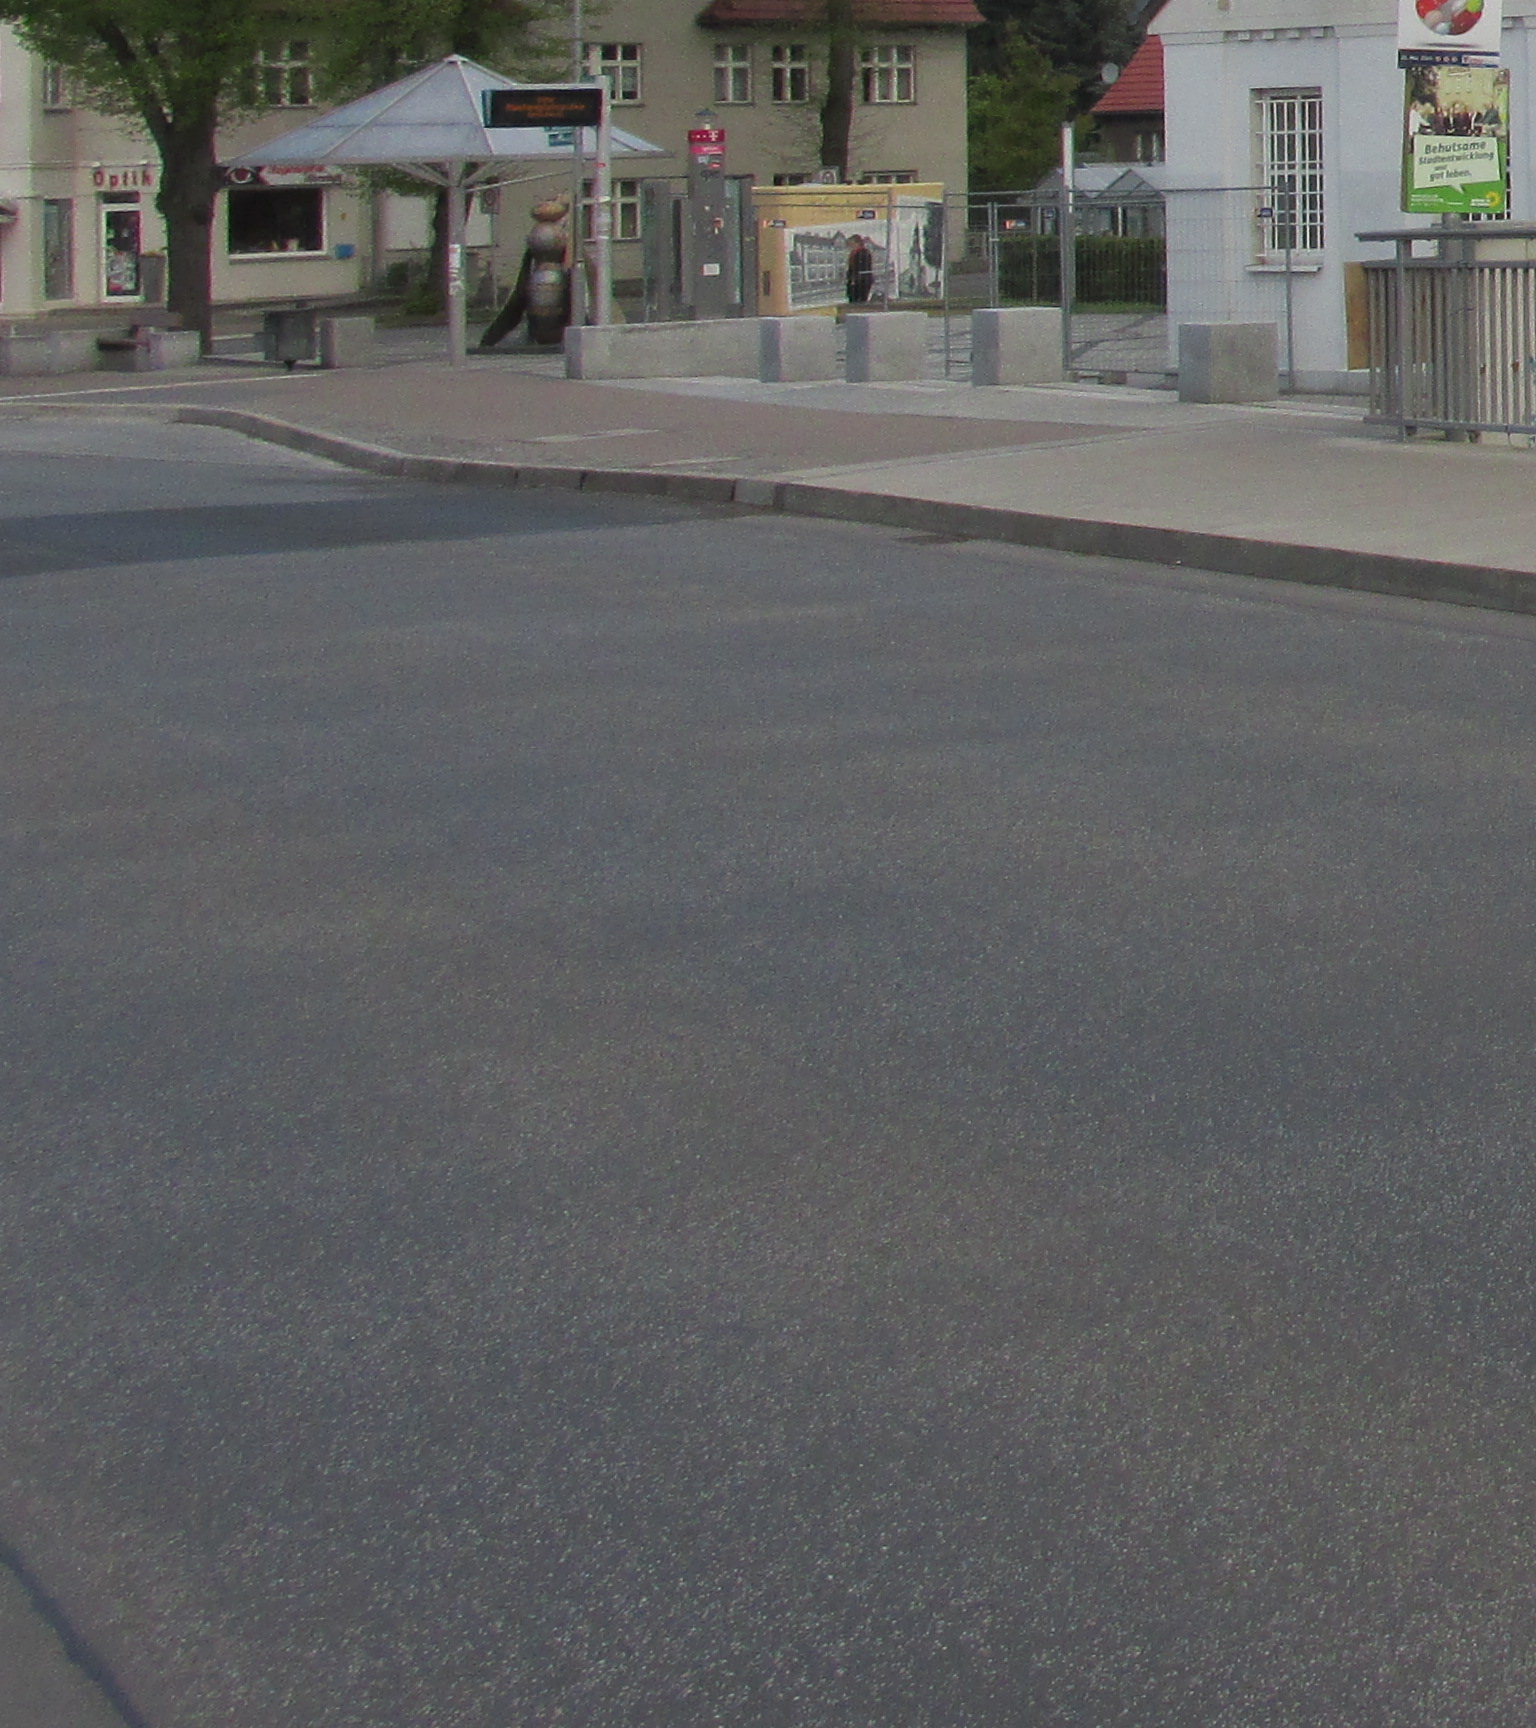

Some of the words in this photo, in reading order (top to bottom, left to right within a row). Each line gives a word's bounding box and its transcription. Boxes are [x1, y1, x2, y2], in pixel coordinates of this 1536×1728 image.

[1424, 141, 1487, 155] Behutsame
[1418, 151, 1495, 166] Stadtentwicklung
[92, 166, 154, 190] Optik
[1429, 171, 1445, 182] gut
